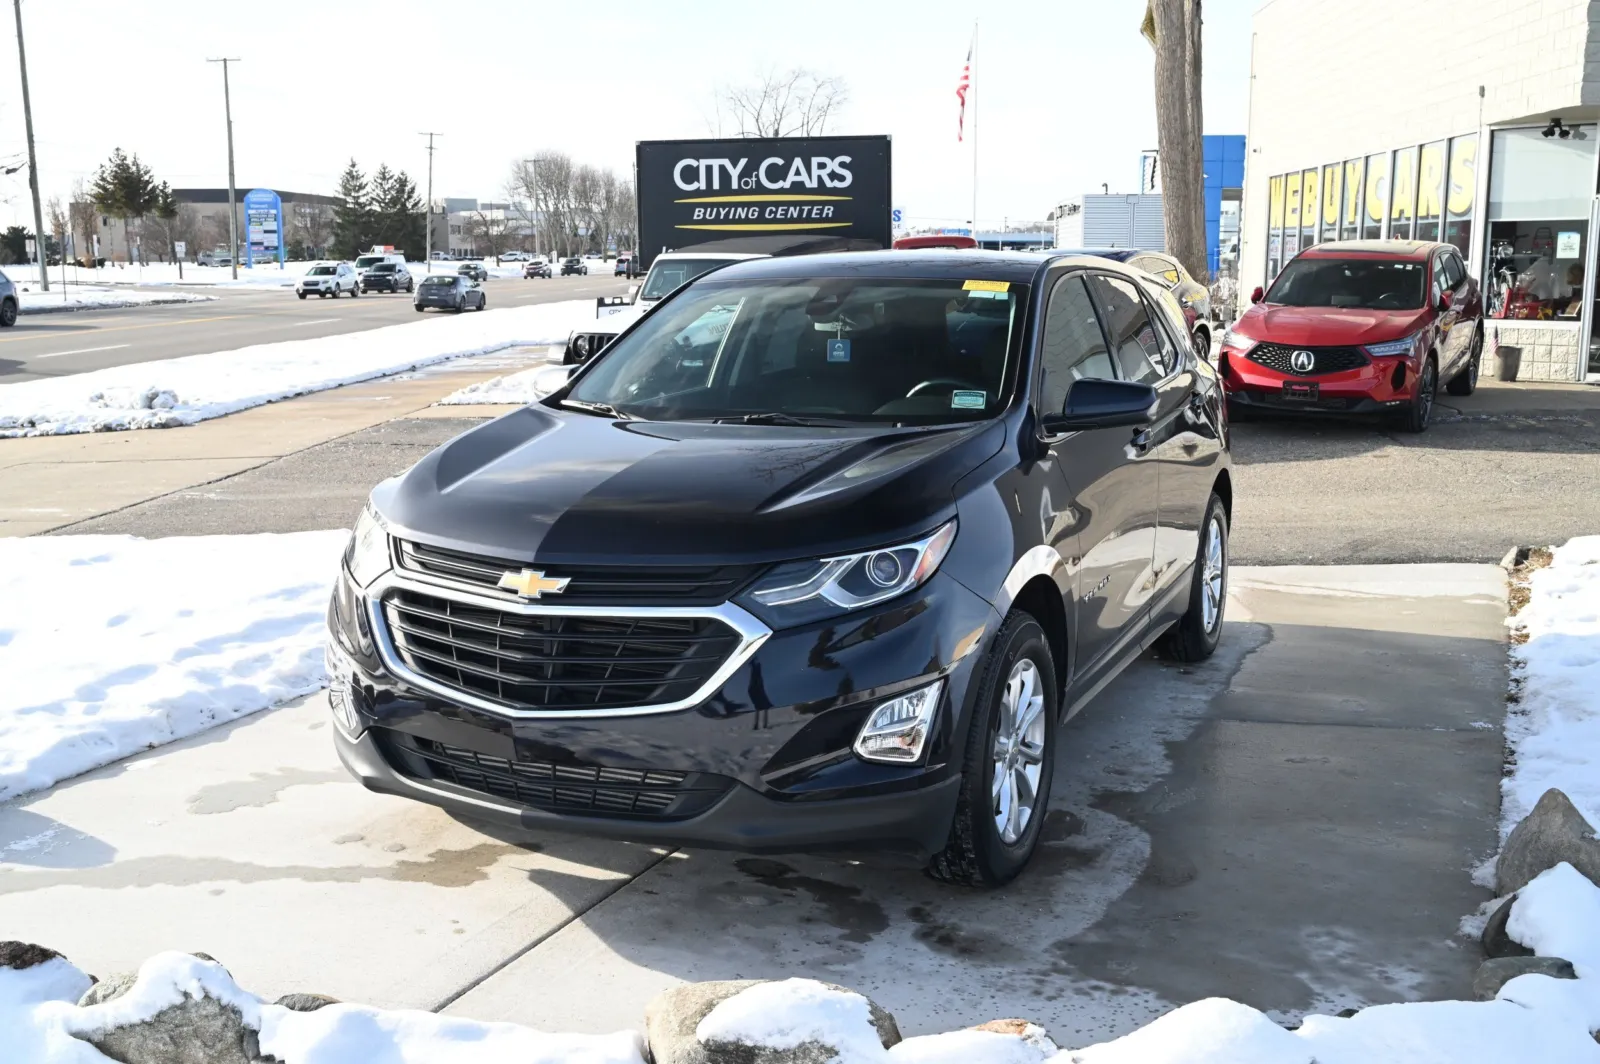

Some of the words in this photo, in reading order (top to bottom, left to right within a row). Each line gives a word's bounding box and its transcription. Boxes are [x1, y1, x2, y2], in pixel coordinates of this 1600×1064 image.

[673, 158, 749, 191] CITY
[741, 172, 758, 189] of
[758, 155, 853, 189] CARS
[693, 207, 760, 220] BUYING
[764, 205, 834, 219] CENTER
